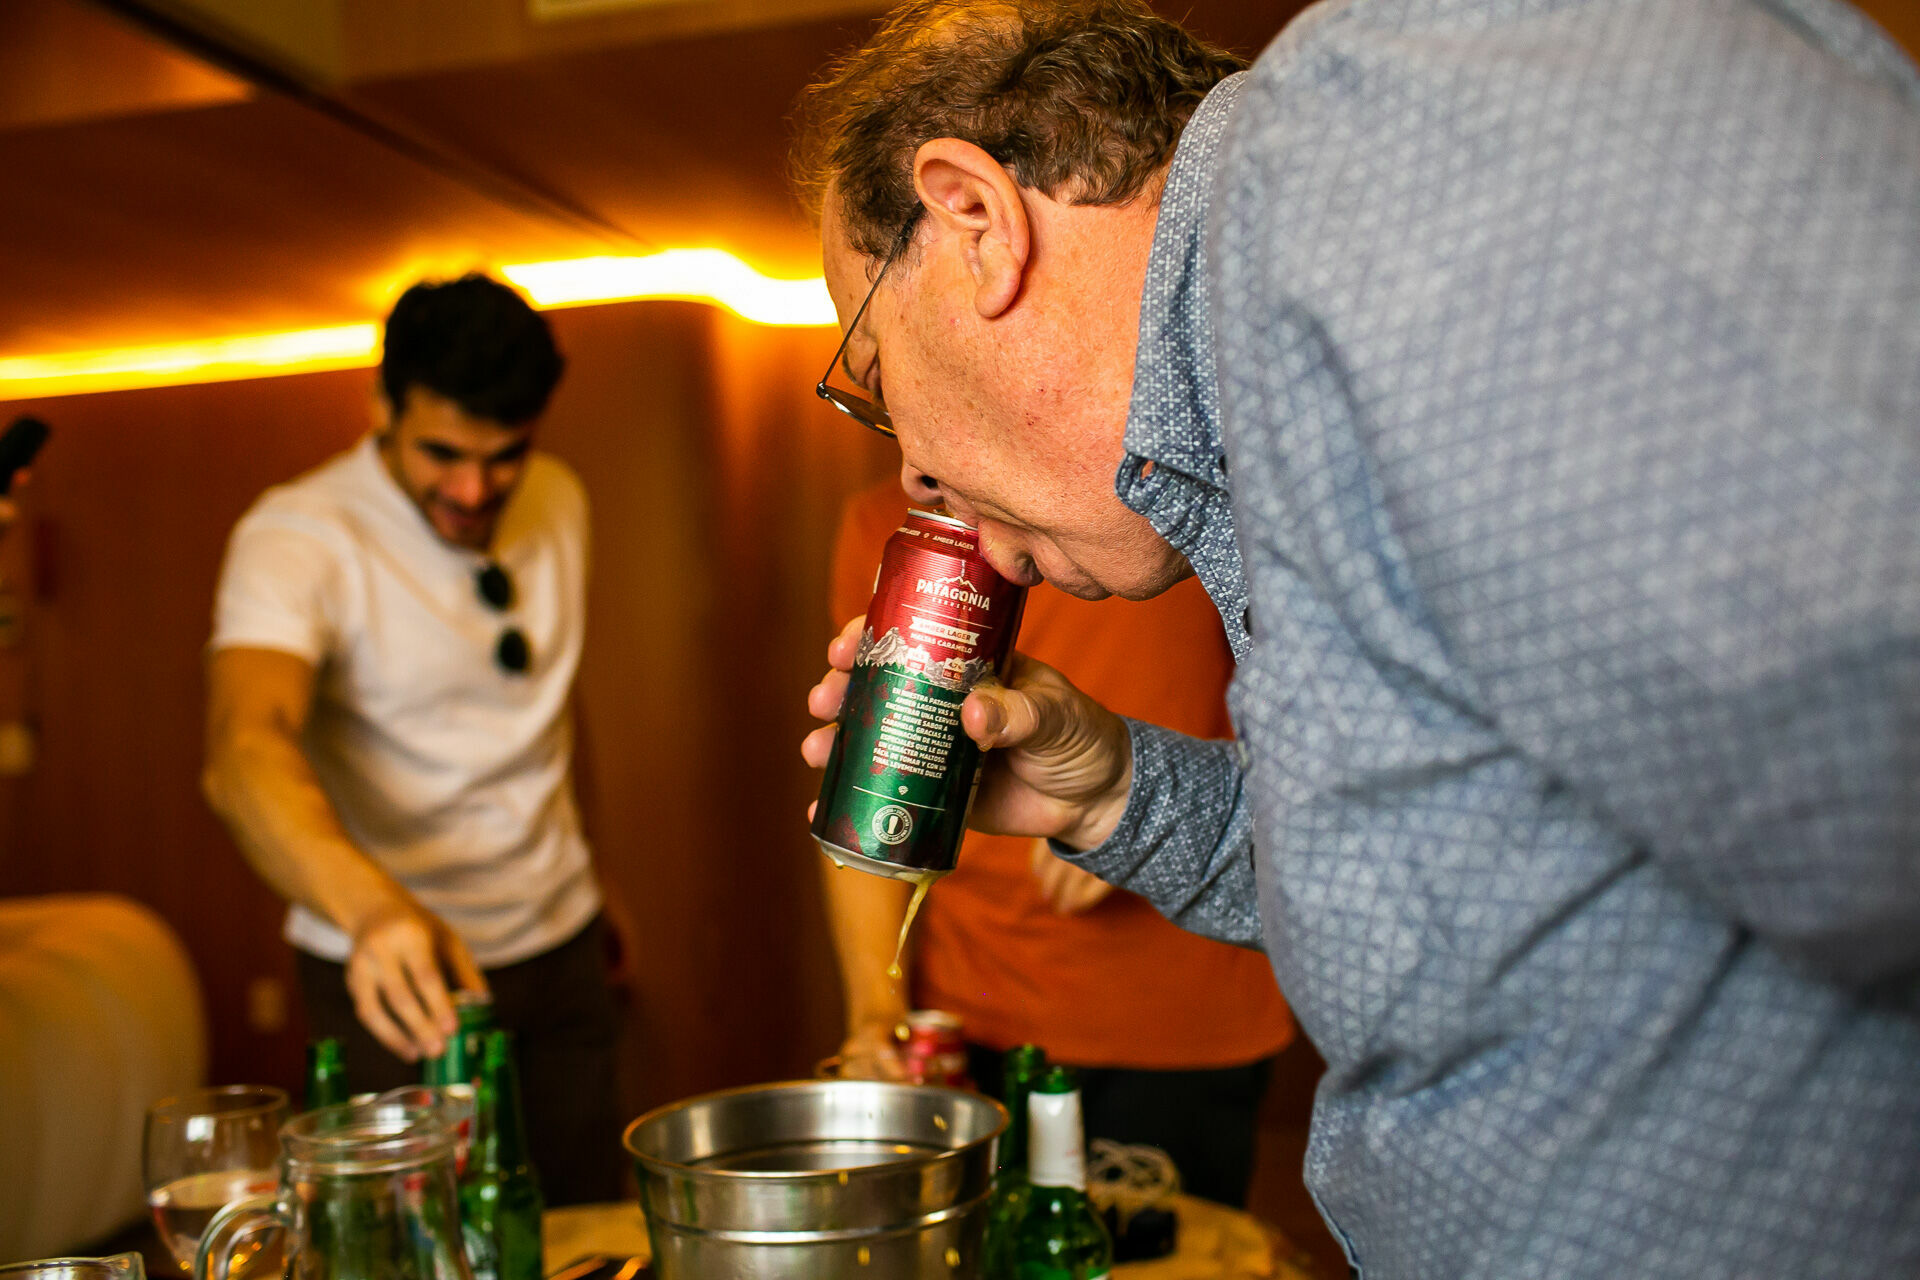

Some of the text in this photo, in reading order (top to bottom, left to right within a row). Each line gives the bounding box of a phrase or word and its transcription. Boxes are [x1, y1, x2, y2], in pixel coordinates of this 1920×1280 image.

[932, 535, 974, 550] AMBER LAGER
[916, 578, 990, 610] PATAGONIA
[947, 630, 971, 640] LAGER
[937, 640, 972, 654] CARAMELO
[901, 689, 929, 702] NUESTRA
[895, 696, 916, 708] AMBER
[917, 702, 937, 712] LAGER
[938, 708, 949, 716] VAS
[902, 714, 922, 726] SUAVE
[922, 720, 943, 730] SABOR
[920, 712, 934, 720] UNA
[934, 716, 959, 726] CERVEZA
[916, 727, 942, 739] GRACIAS
[916, 743, 928, 752] QUE
[931, 740, 952, 748] MALTAS
[890, 760, 924, 776] LEVEMENTE
[900, 755, 920, 767] TOMAR
[926, 762, 939, 770] CON
